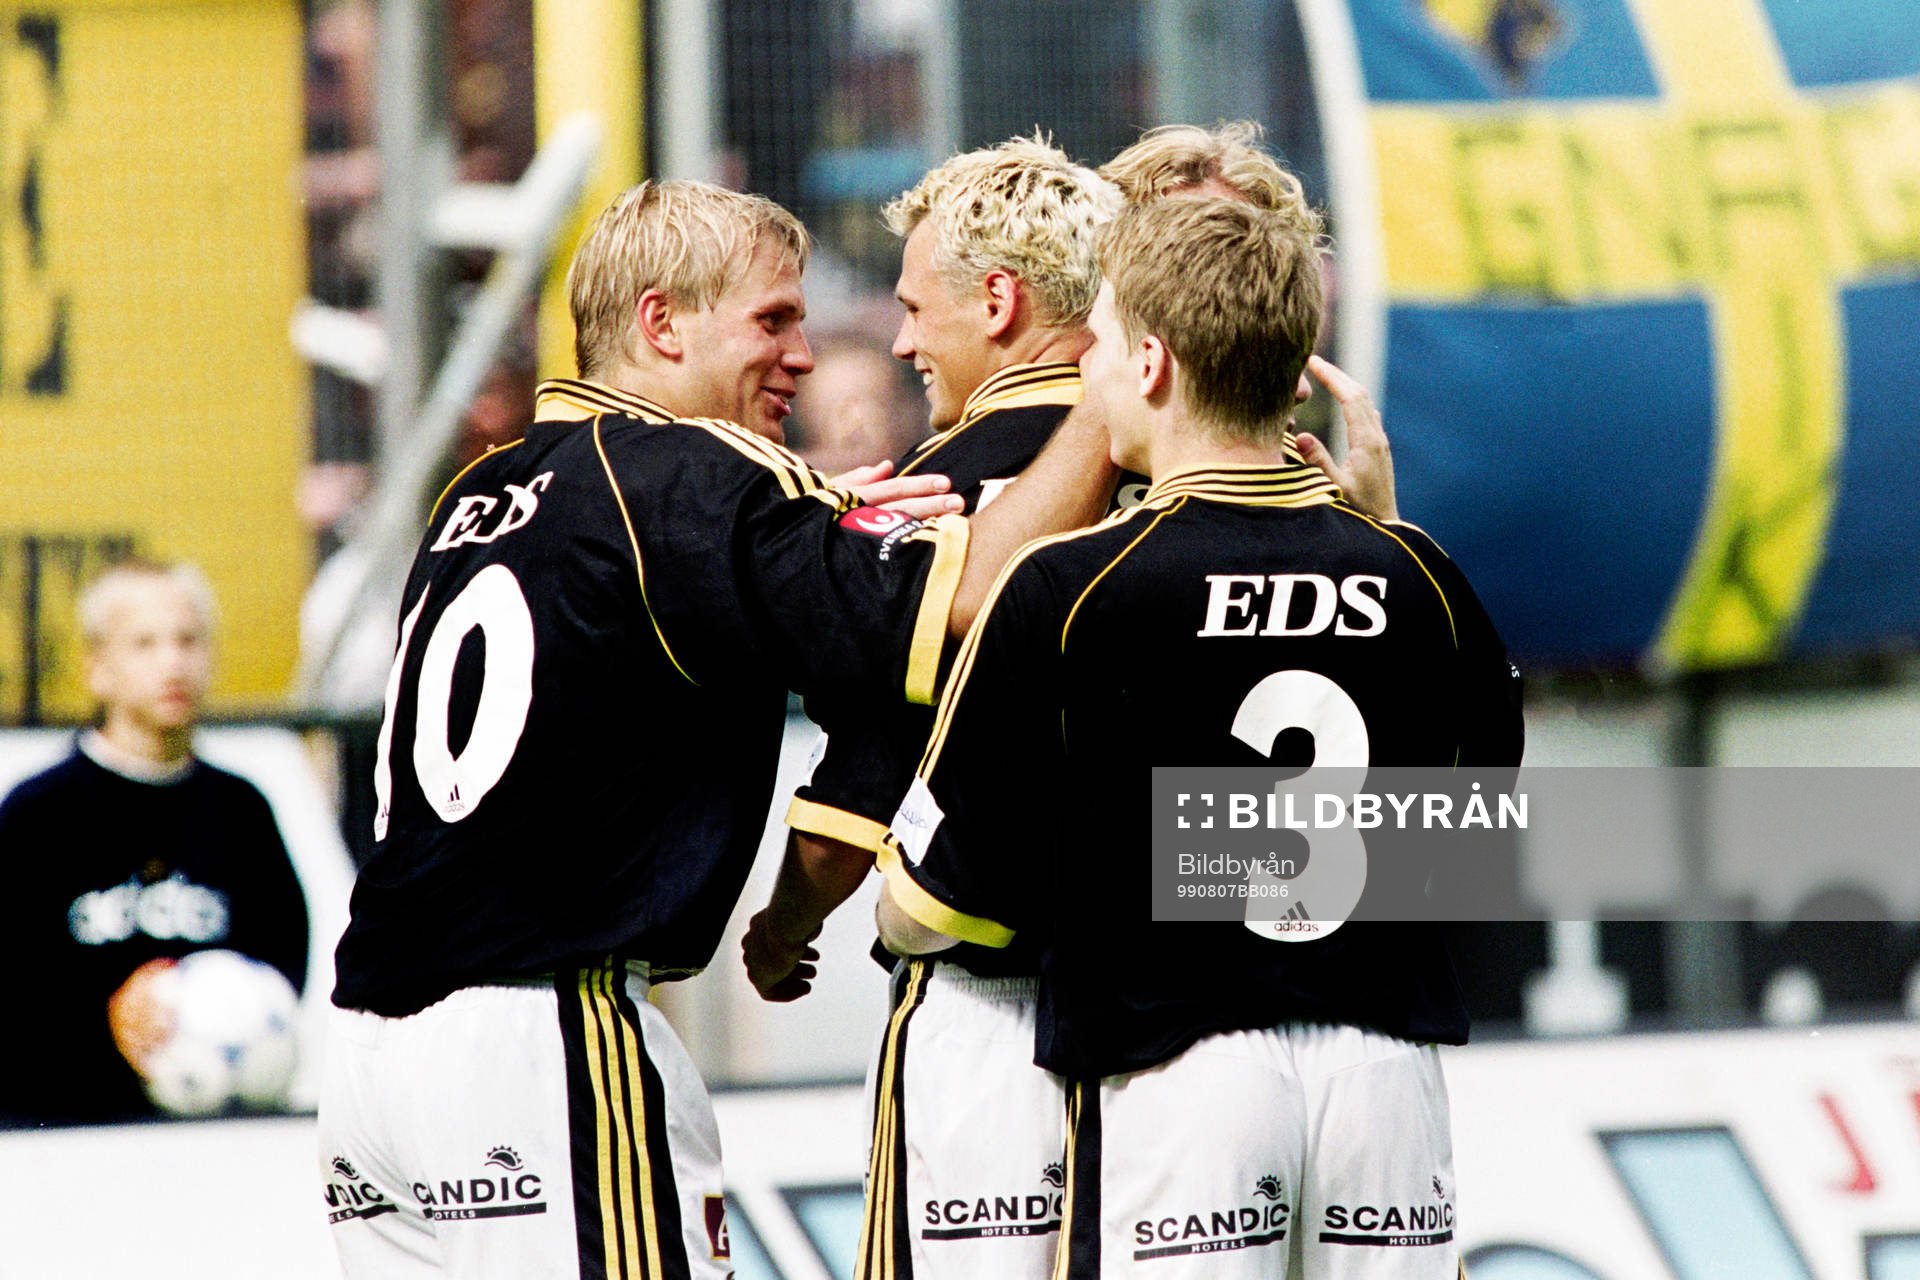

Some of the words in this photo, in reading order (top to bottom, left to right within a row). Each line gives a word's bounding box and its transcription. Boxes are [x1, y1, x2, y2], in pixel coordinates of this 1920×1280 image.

[430, 471, 554, 552] EDS
[1197, 574, 1388, 637] EDS
[374, 563, 535, 842] 10
[1230, 669, 1369, 943] 3
[1274, 920, 1319, 932] adidas
[324, 1182, 384, 1207] NDIC
[412, 1174, 542, 1206] CNDIC
[433, 1210, 477, 1221] OTELS
[1135, 1203, 1290, 1246] SCANDIC
[1324, 1202, 1453, 1231] SCANDIC
[981, 1226, 1030, 1237] HOTELS
[1389, 1236, 1432, 1246] HOTELS
[1191, 1239, 1247, 1254] HOTELS
